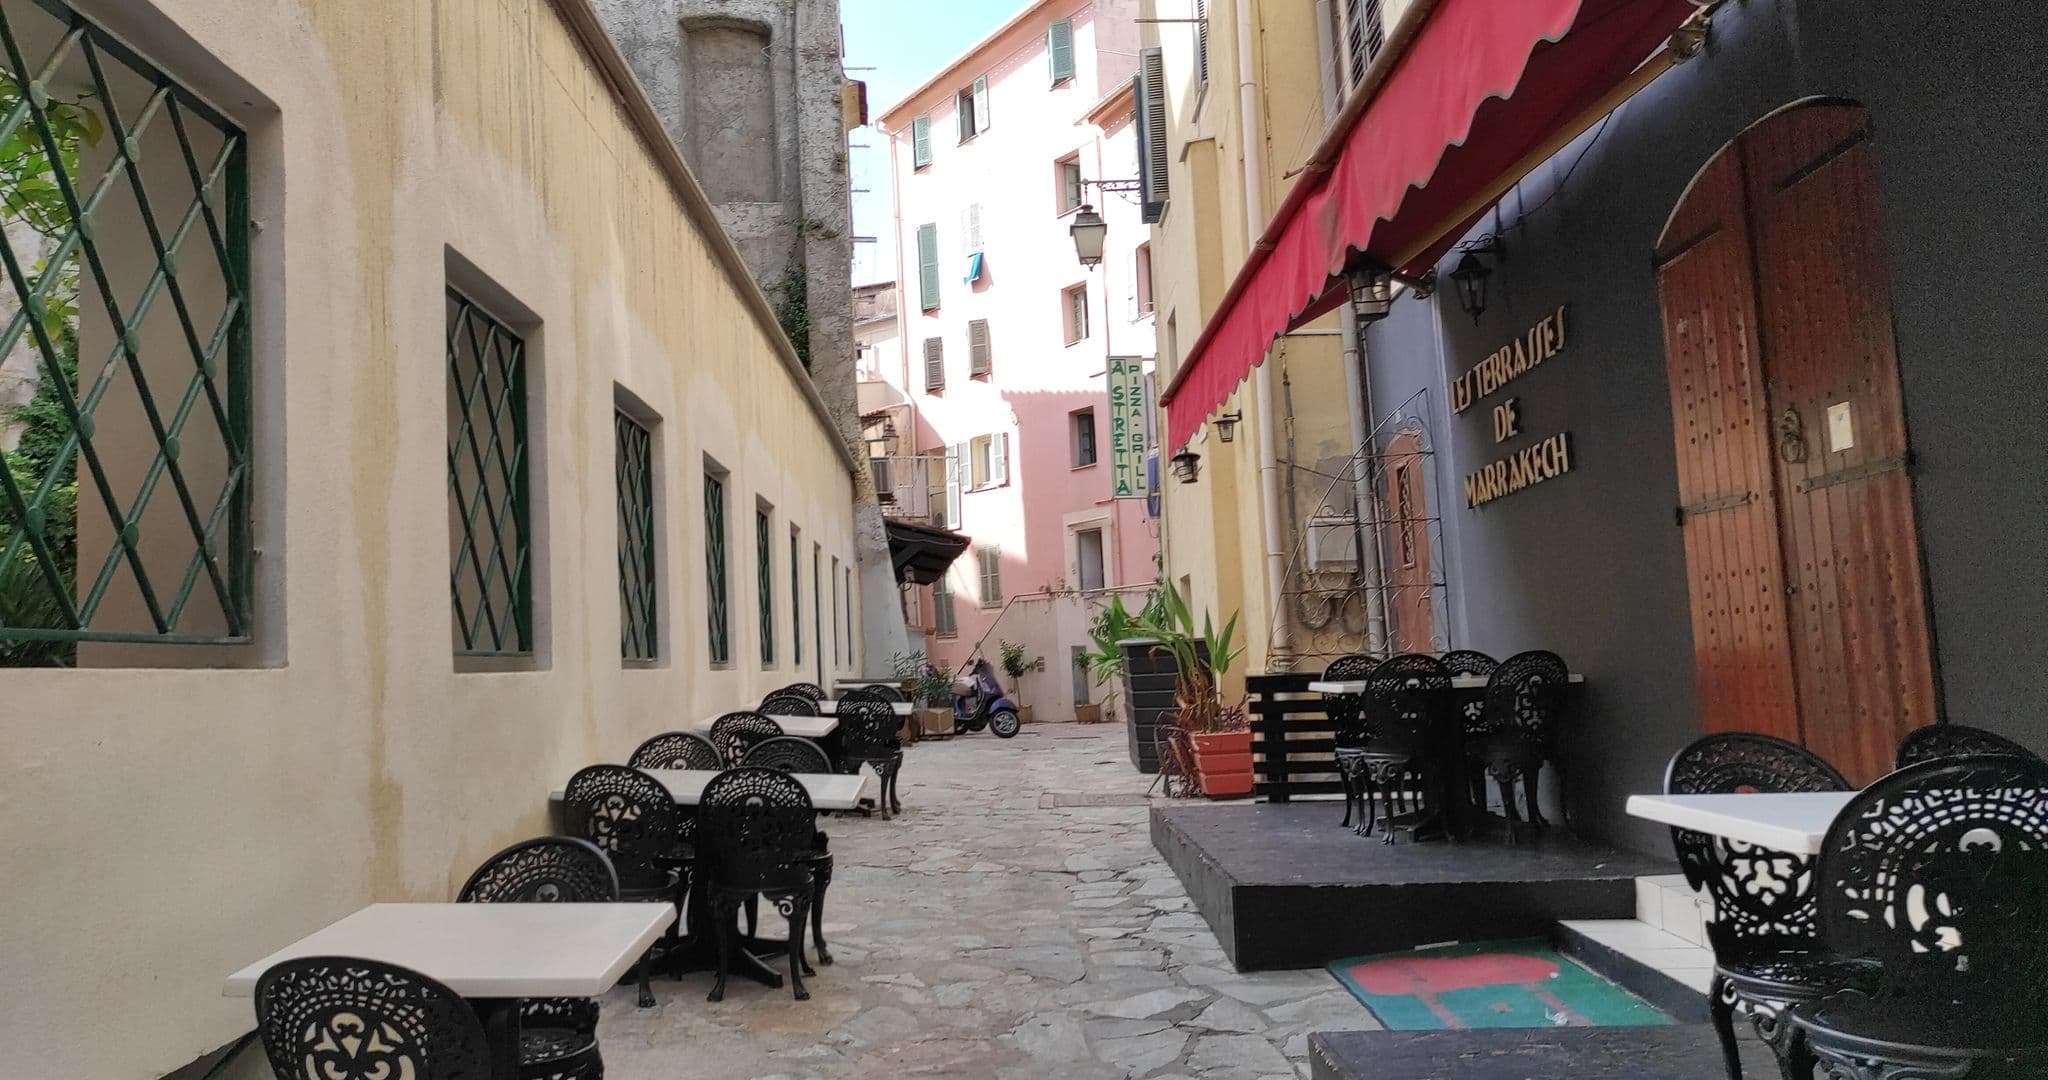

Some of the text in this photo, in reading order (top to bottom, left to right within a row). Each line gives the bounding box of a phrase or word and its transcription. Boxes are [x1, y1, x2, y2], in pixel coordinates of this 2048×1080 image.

[1451, 305, 1566, 415] LES TERRASSES
[1111, 361, 1130, 494] A STRETTA
[1493, 399, 1518, 443] DE
[1464, 433, 1569, 507] MARRAKECH
